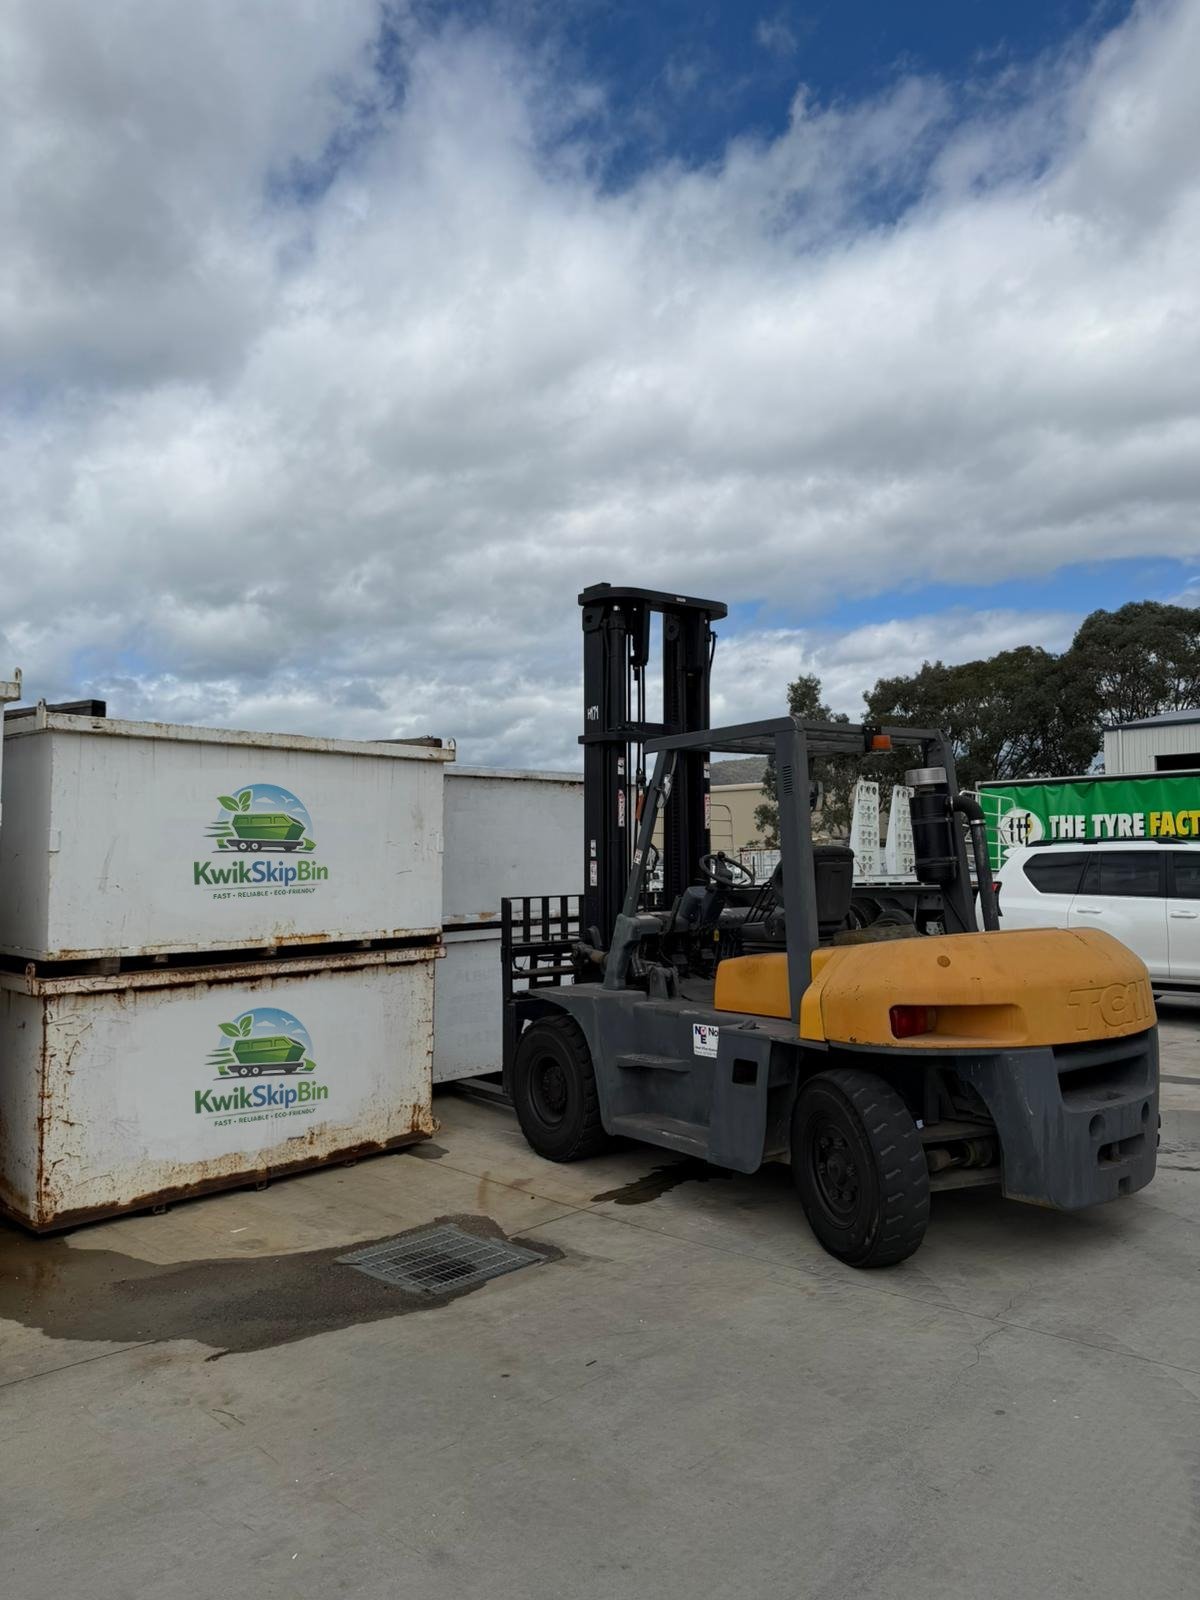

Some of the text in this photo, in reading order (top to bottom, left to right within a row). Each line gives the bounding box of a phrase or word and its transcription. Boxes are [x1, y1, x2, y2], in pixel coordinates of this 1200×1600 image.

[1049, 810, 1200, 838] THE TYRE FACT
[193, 860, 329, 886] KwikSkipBin
[212, 887, 316, 900] FAST RELIABLE ECO-FRIENDLY
[194, 1080, 329, 1114] KwikSkipBin
[213, 1107, 316, 1127] FAST RELIABLE ECO-FRIENDLY
